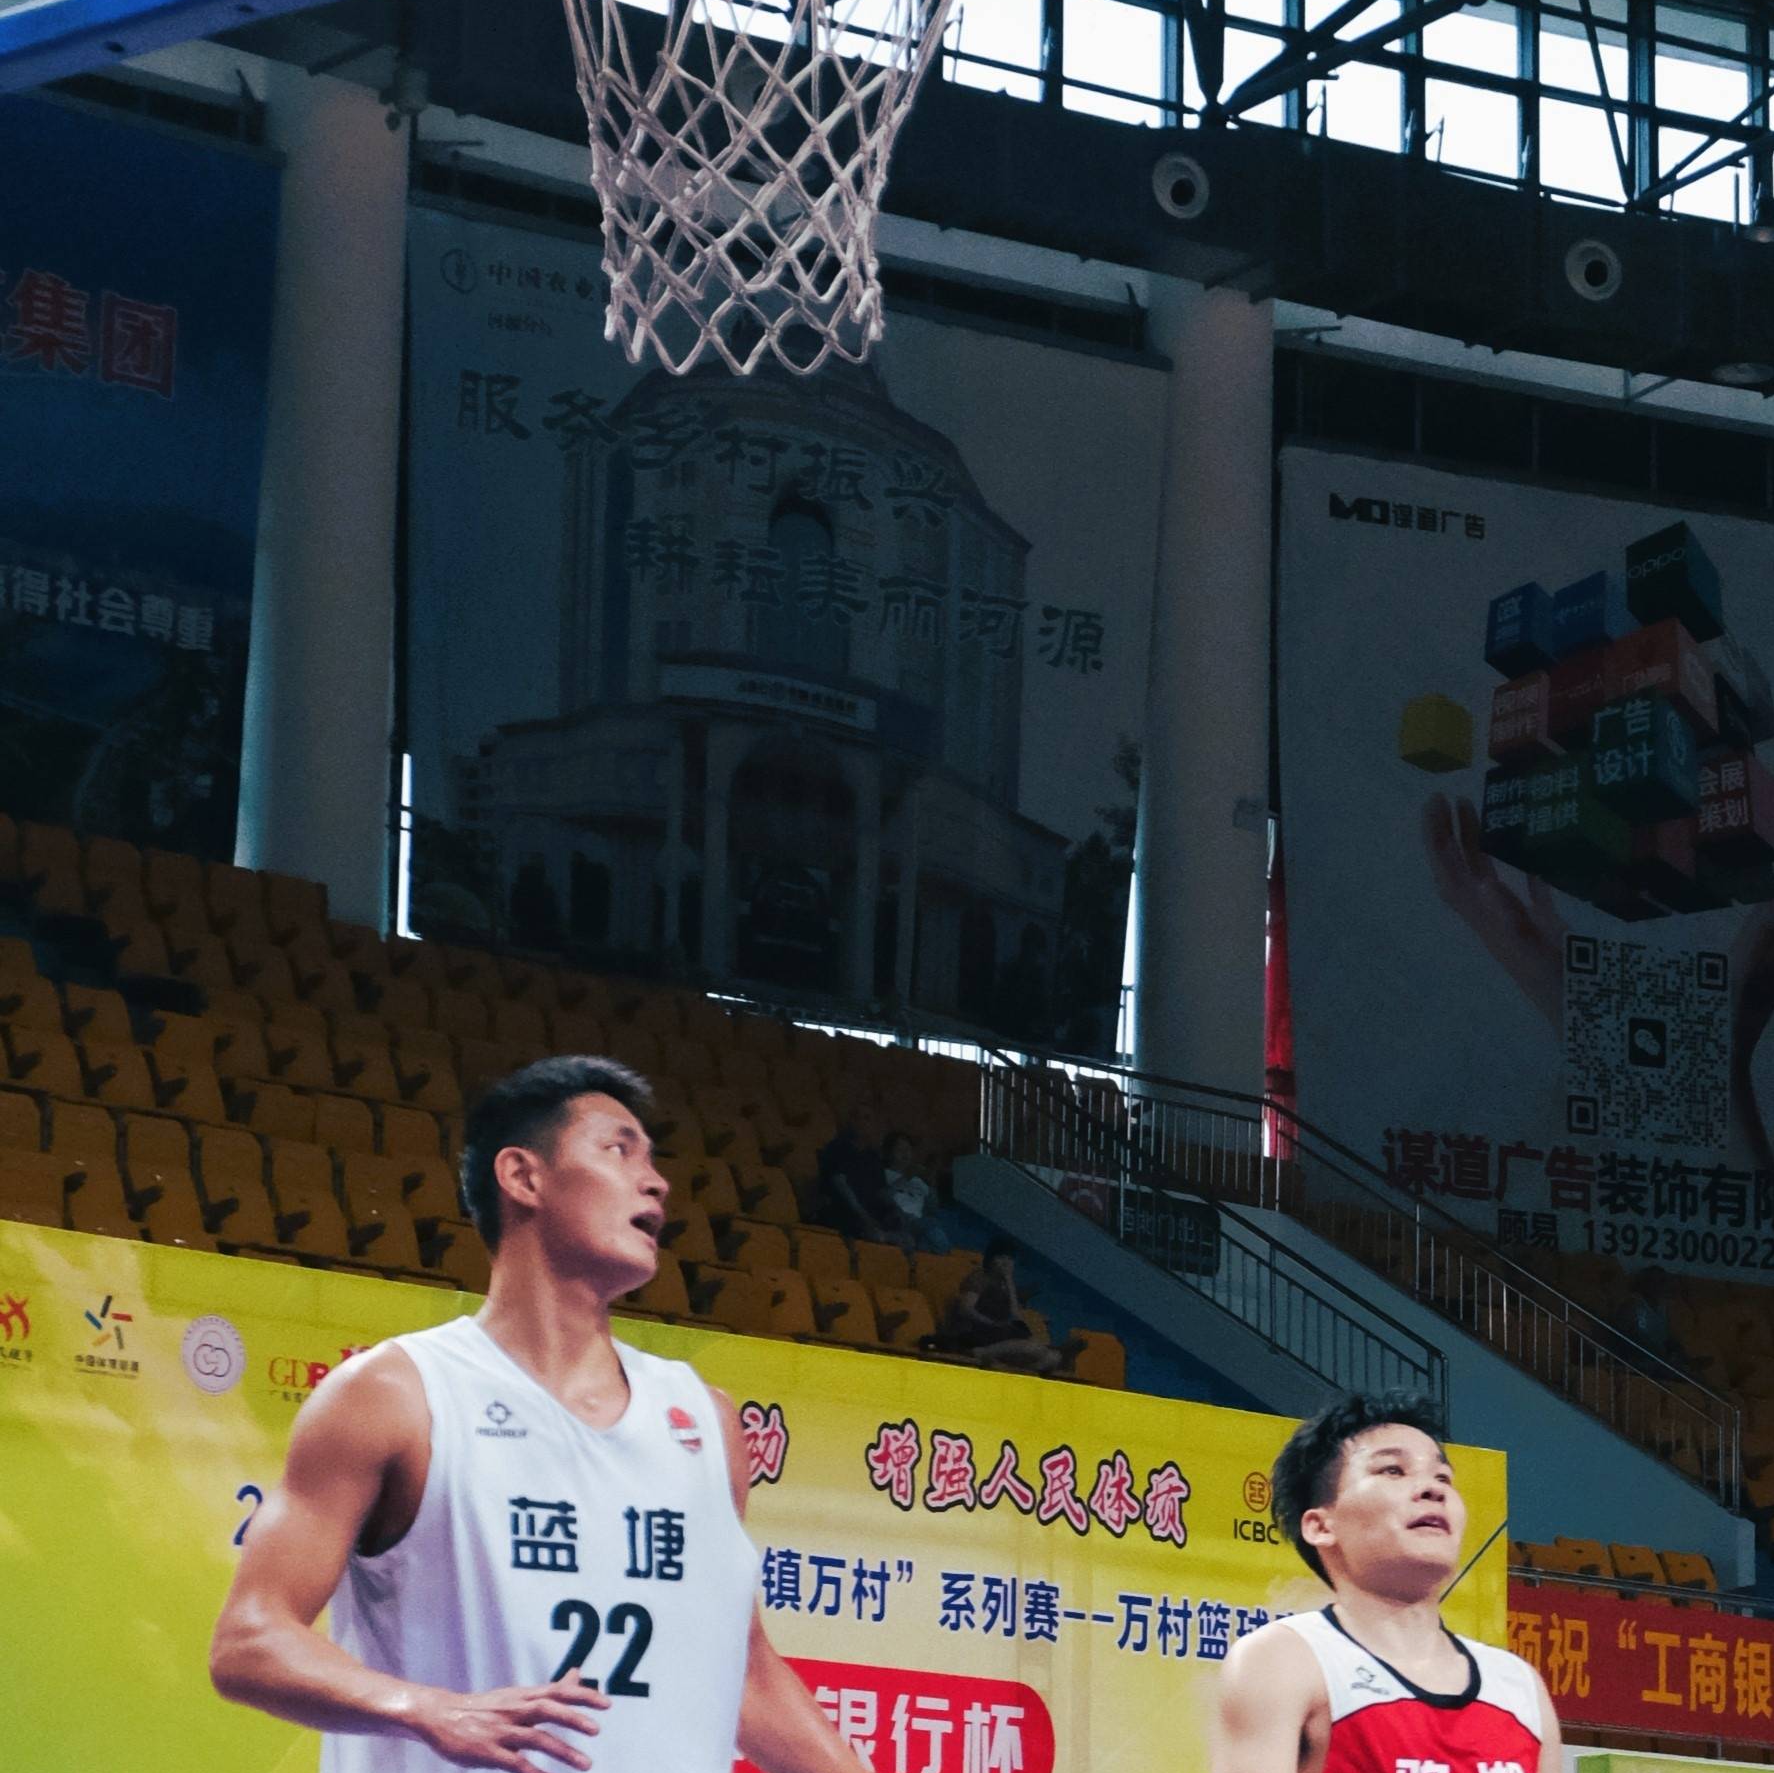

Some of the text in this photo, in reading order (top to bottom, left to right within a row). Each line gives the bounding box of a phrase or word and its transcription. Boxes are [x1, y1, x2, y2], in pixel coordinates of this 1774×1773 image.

[0, 267, 178, 400] 集团
[456, 367, 957, 529] 服务乡村振兴
[0, 563, 216, 653] 得社会尊重
[625, 514, 1107, 676] 耕耘美丽河源
[1592, 698, 1654, 743] 广告
[1592, 743, 1655, 786] 设计
[1497, 1207, 1560, 1251] 顾易
[866, 1418, 1191, 1549] 增强人民体质
[508, 1495, 686, 1582] 蓝塘
[1233, 1518, 1279, 1545] ICBC
[550, 1598, 654, 1698] 22
